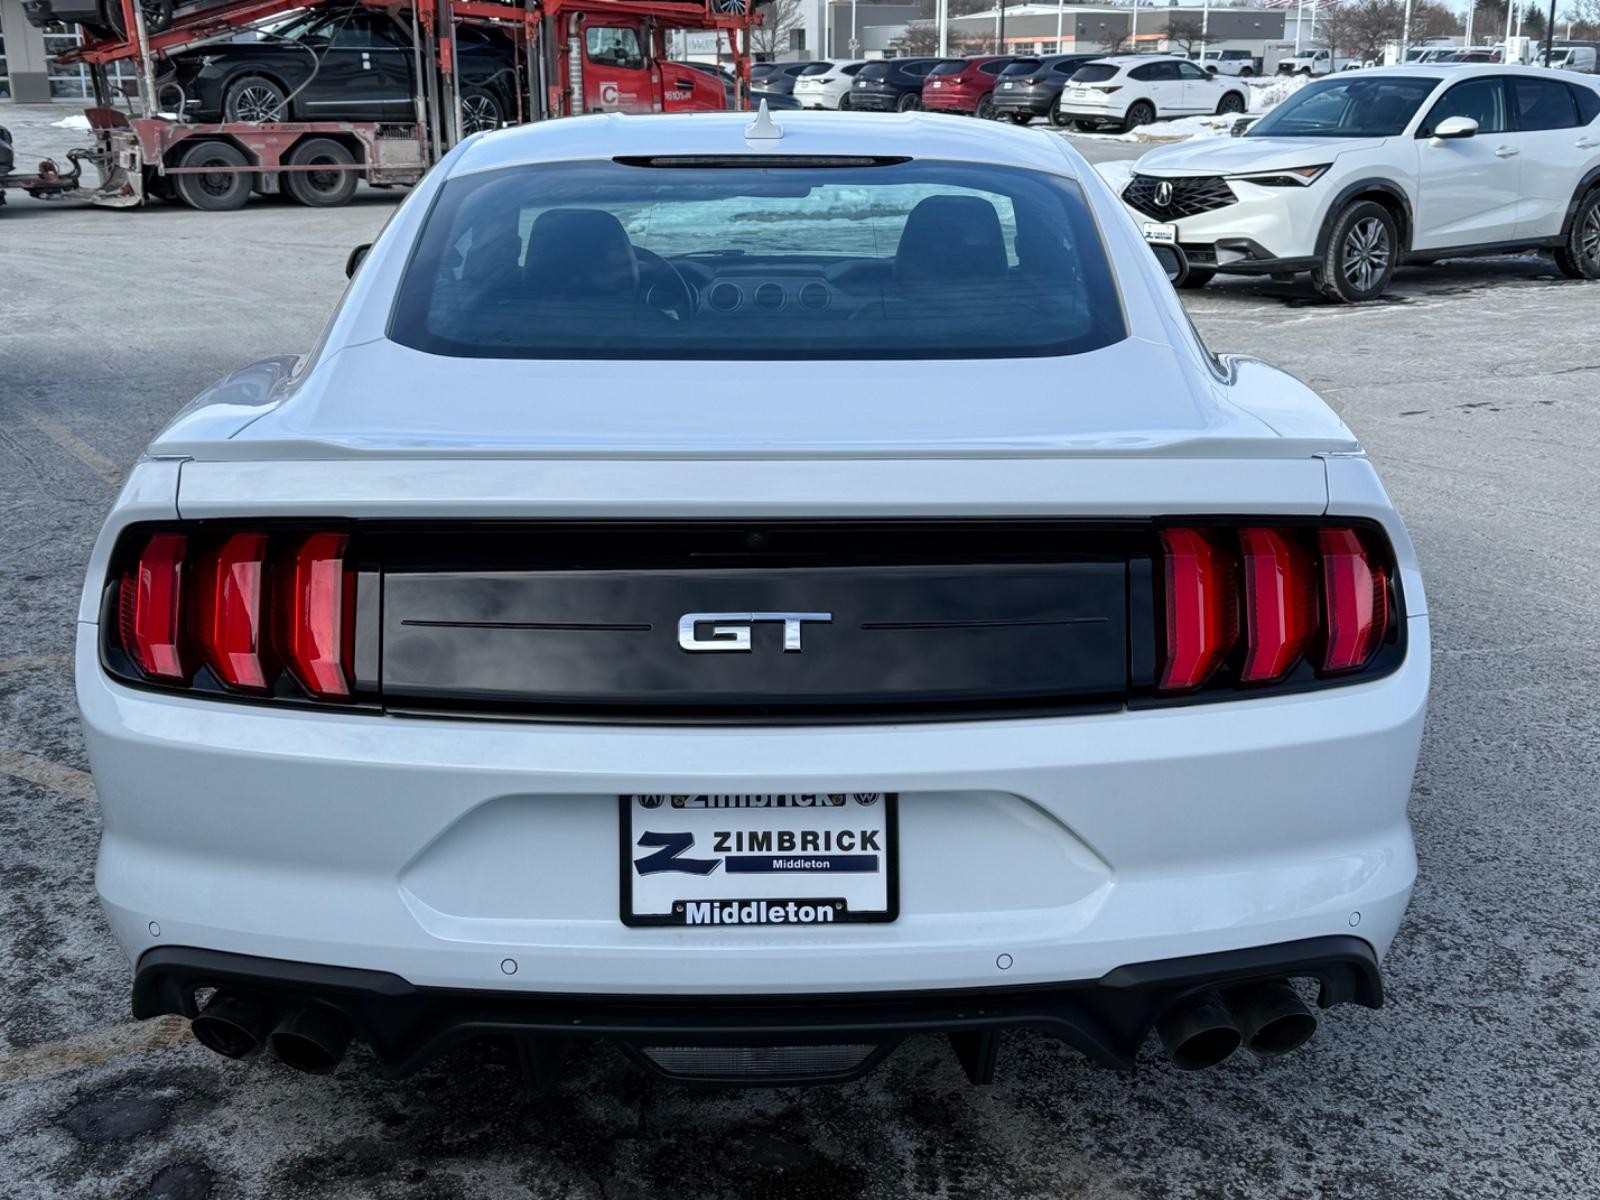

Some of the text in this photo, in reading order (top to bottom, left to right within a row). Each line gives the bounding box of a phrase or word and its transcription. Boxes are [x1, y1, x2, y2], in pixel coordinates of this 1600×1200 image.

[678, 612, 833, 651] GT
[713, 830, 881, 852] ZIMBRICK
[772, 858, 830, 869] Middleton
[685, 901, 834, 925] Middleton
